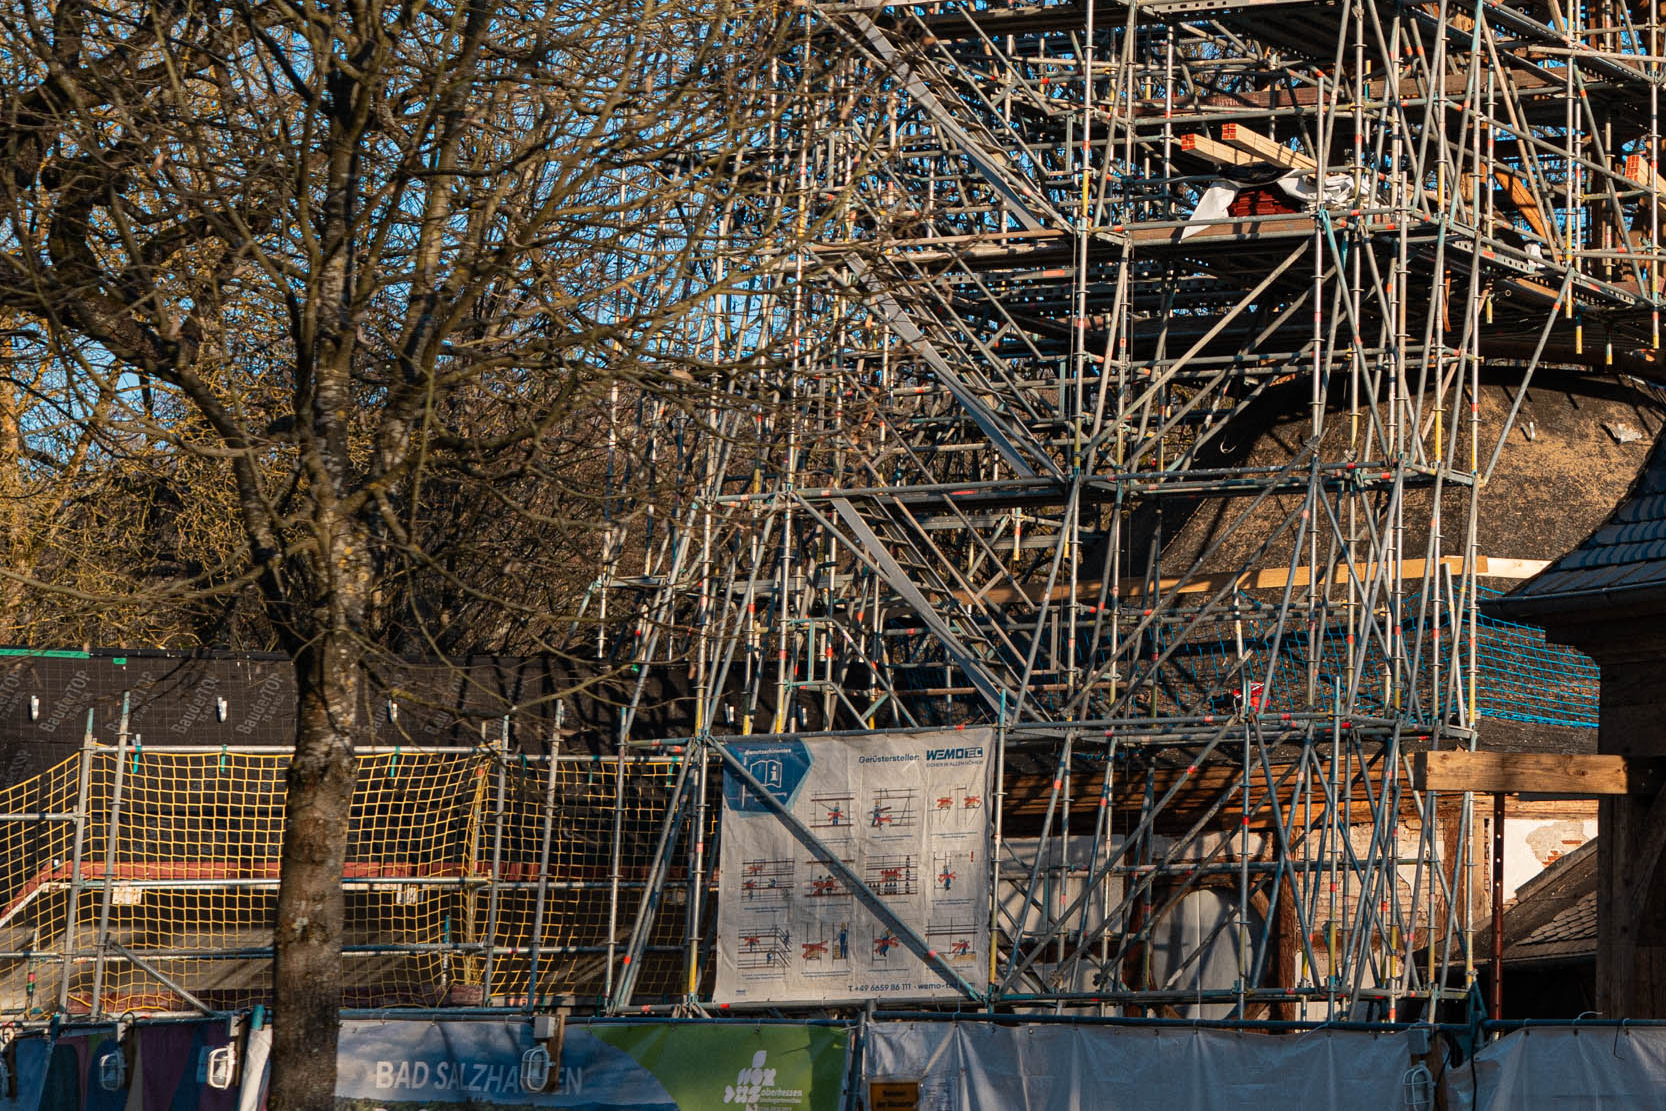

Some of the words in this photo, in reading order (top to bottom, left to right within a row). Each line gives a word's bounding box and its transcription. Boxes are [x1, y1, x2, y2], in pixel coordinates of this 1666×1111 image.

[858, 753, 920, 764] Gerüstersteller:
[870, 984, 889, 992] 6659
[375, 1060, 430, 1090] BAD
[433, 1061, 584, 1097] SALZHAEN
